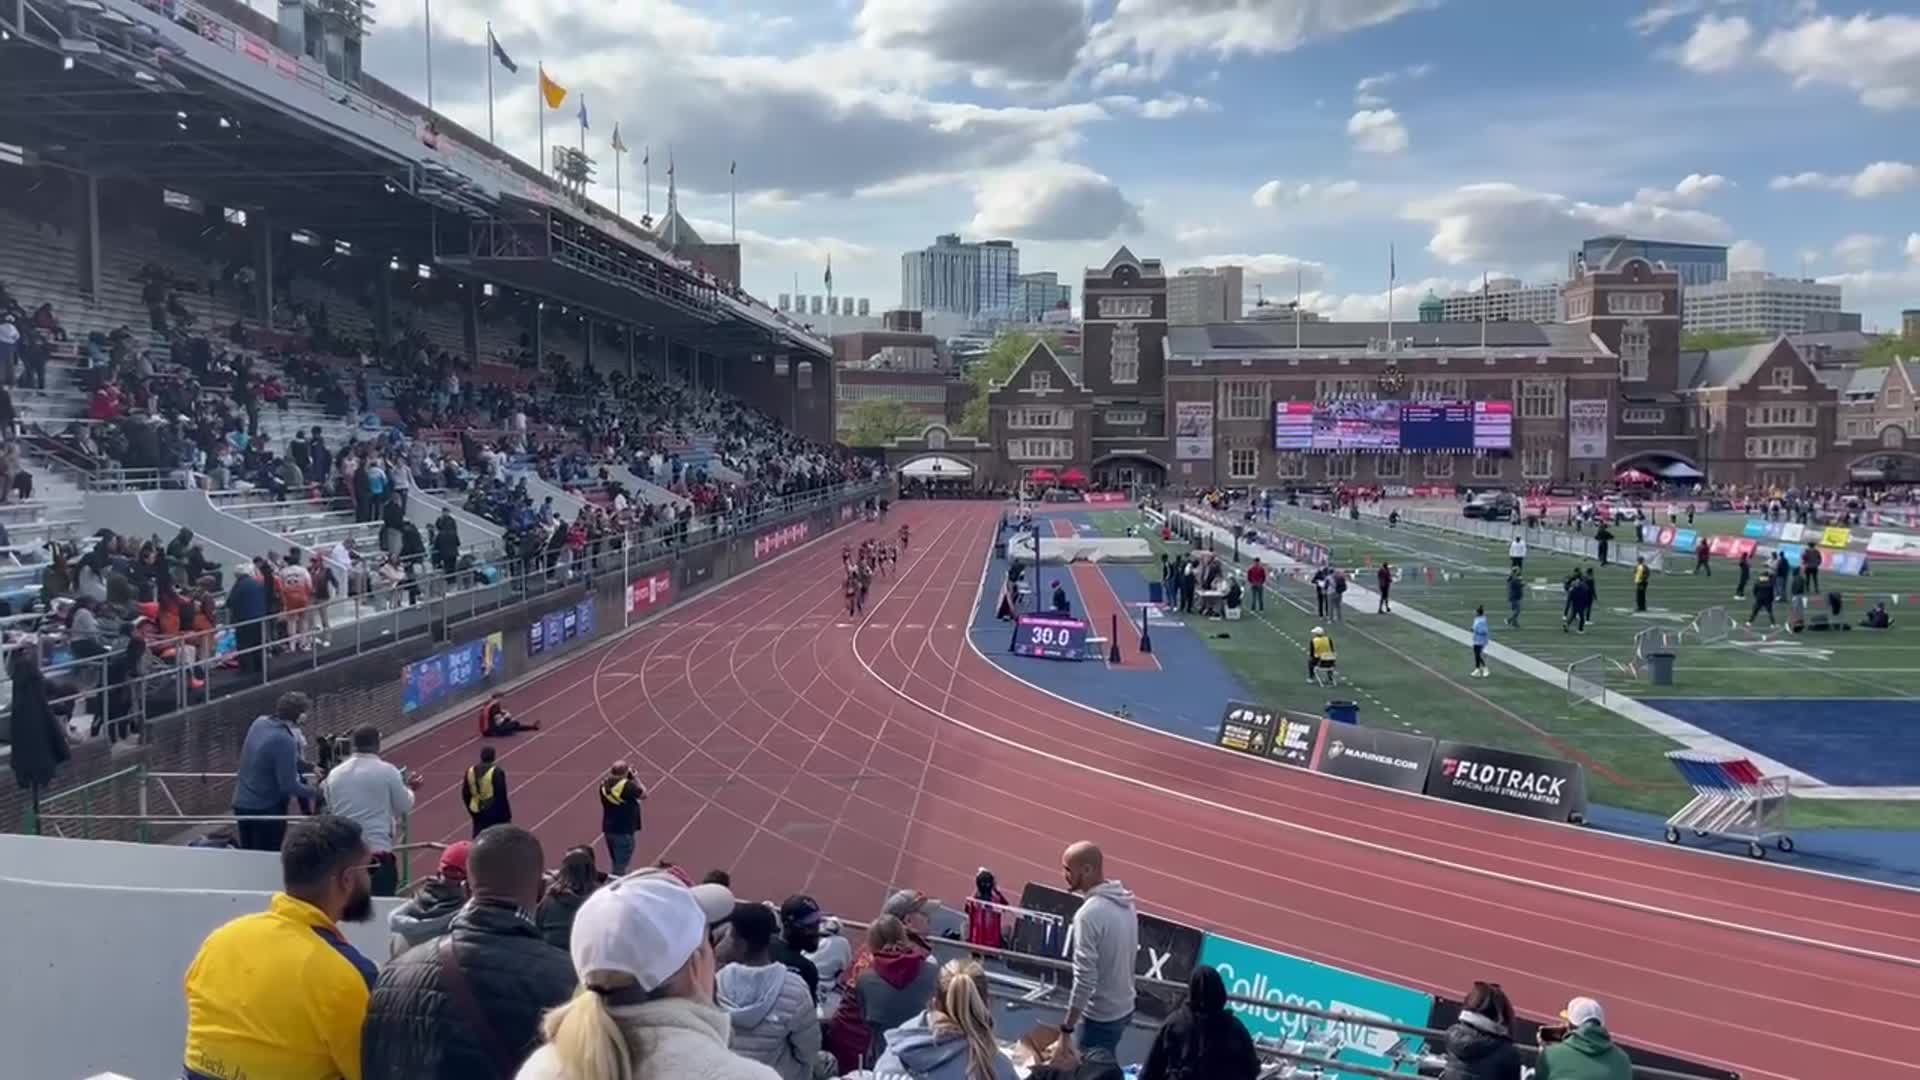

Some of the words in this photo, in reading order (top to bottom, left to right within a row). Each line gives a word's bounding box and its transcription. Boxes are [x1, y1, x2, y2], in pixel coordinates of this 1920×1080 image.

[1032, 627, 1069, 645] 30.0
[1344, 748, 1418, 770] MARINES.COM
[1455, 760, 1567, 797] FLOTRACK
[1452, 779, 1483, 791] OFFICIAL
[1485, 784, 1500, 794] LIVE
[1501, 787, 1528, 799] STREAM
[1529, 793, 1560, 805] PARTNER
